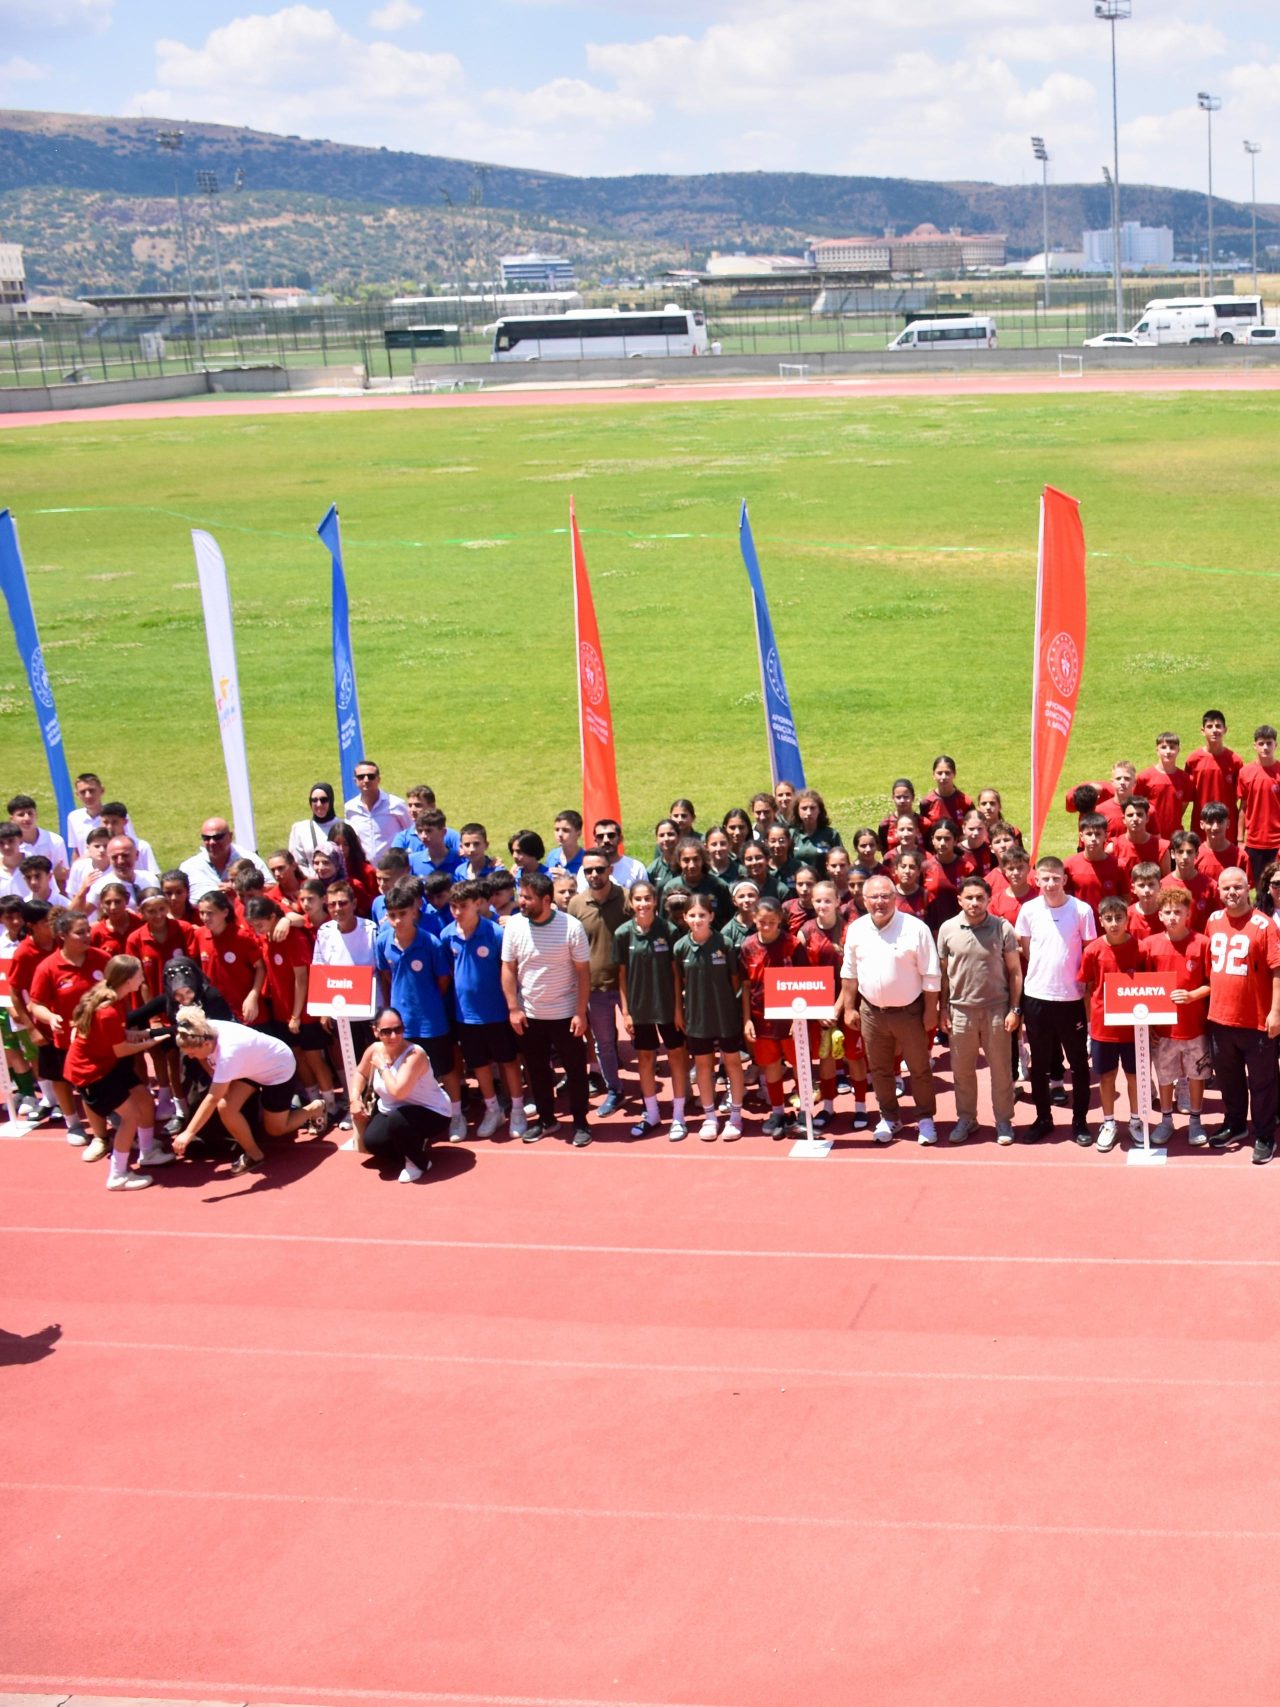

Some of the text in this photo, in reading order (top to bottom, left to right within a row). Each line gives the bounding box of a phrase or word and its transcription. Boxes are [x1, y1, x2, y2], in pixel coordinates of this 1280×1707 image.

[1210, 932, 1250, 976] 92
[326, 978, 353, 989] İZMİR
[776, 980, 826, 991] İSTANBUL
[1117, 986, 1166, 997] SAKARYA
